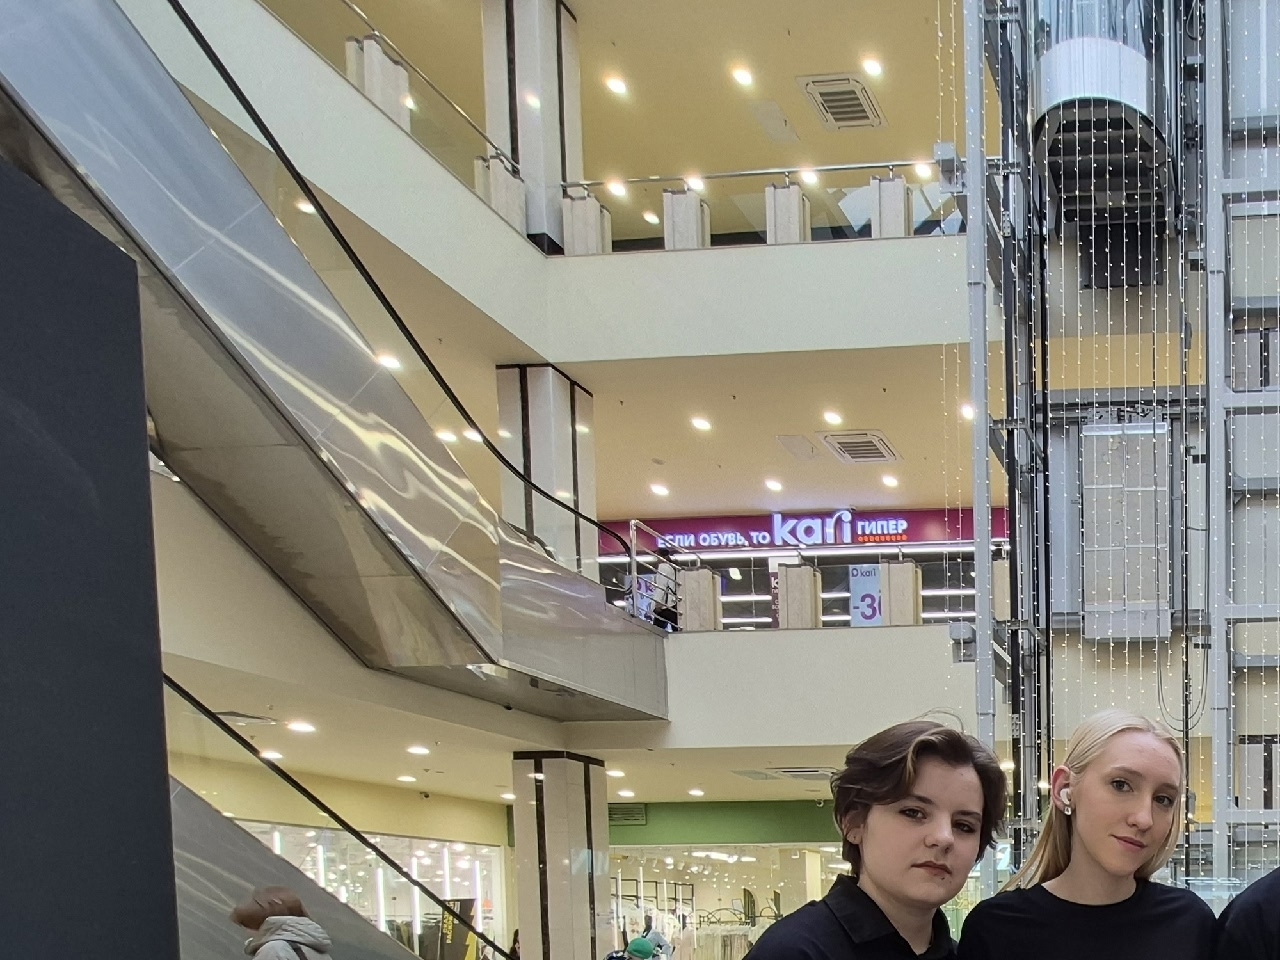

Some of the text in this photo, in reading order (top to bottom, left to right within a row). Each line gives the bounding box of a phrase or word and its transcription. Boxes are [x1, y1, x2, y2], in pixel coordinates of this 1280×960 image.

[773, 510, 852, 546] kari
[857, 519, 908, 535] ГИПЕР
[657, 531, 771, 548] ЕСЛИ ОБУВЬ, ТО
